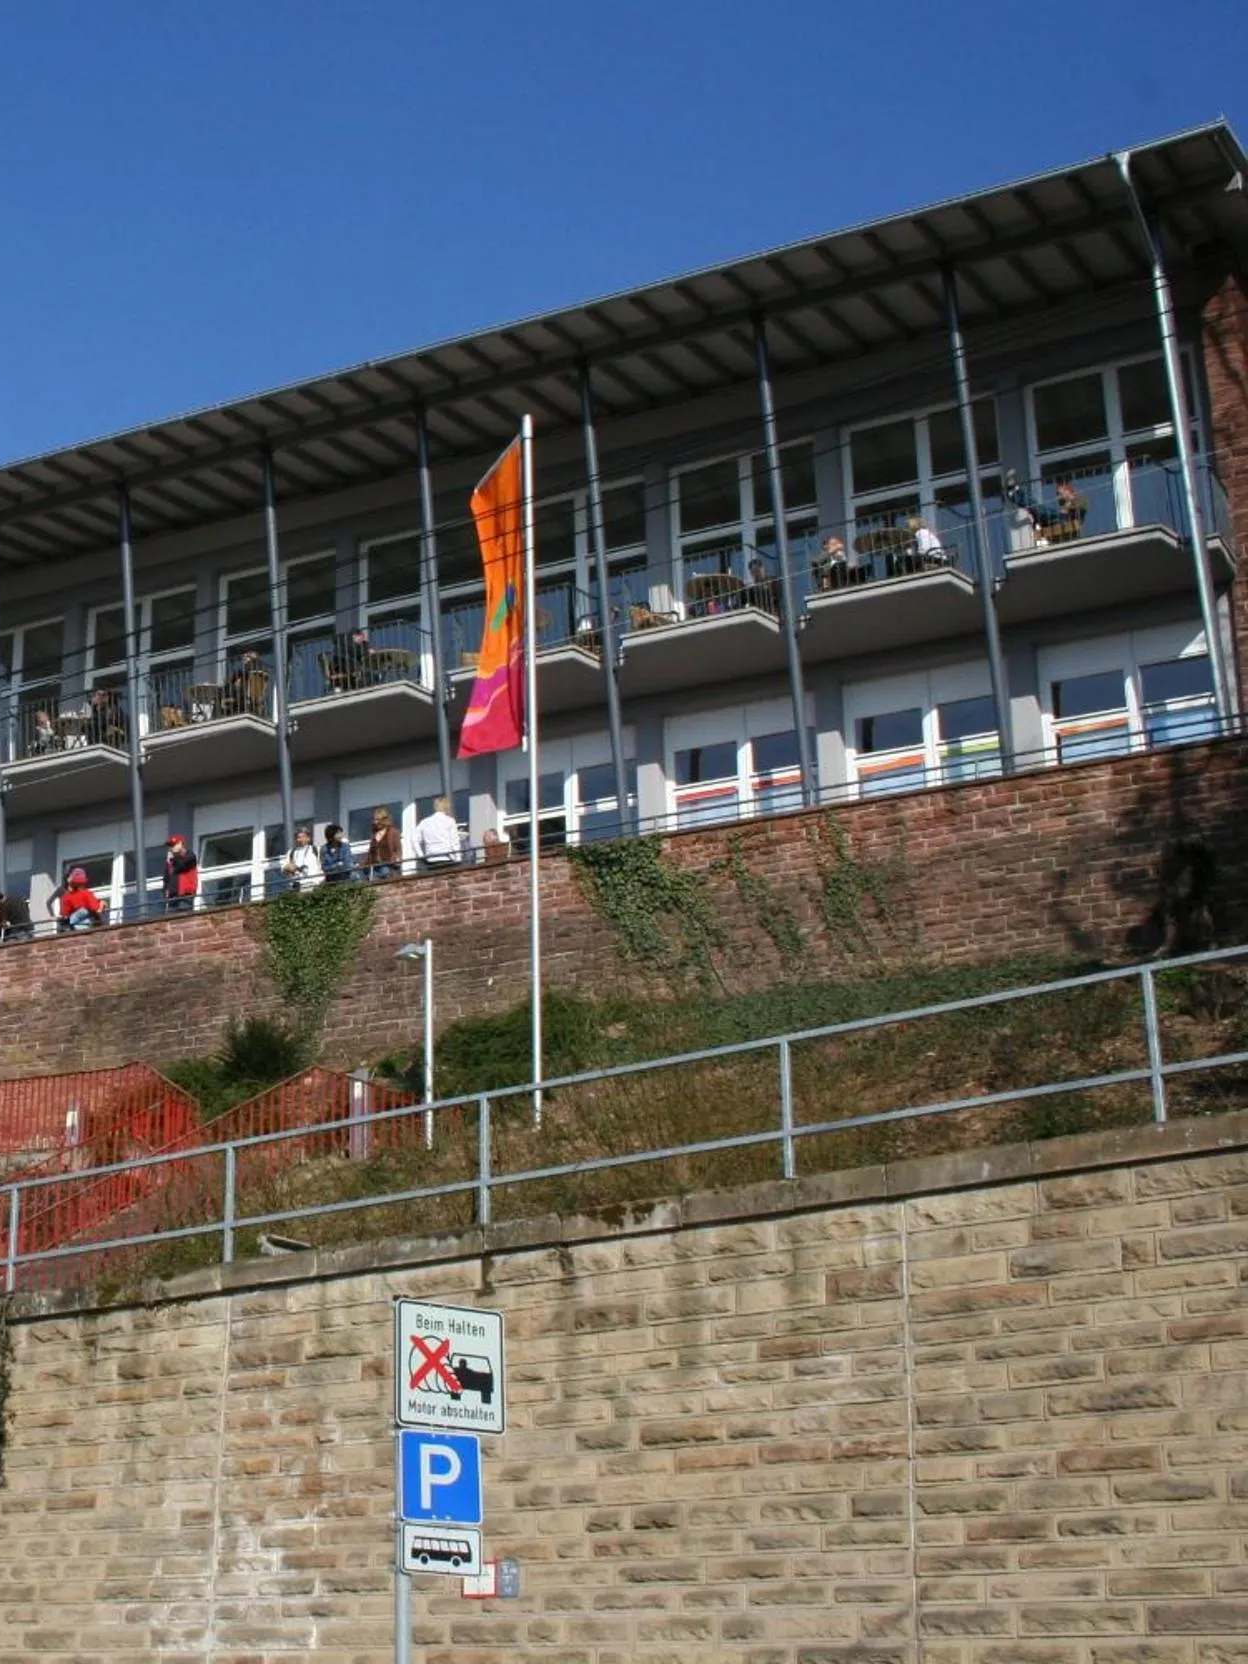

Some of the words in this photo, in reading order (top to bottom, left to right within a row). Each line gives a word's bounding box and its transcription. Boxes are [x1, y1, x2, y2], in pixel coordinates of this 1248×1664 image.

[415, 1313, 444, 1331] Beim
[448, 1317, 485, 1338] Halten
[408, 1398, 436, 1416] Motor
[440, 1403, 495, 1422] abschalten
[420, 1442, 461, 1509] P
